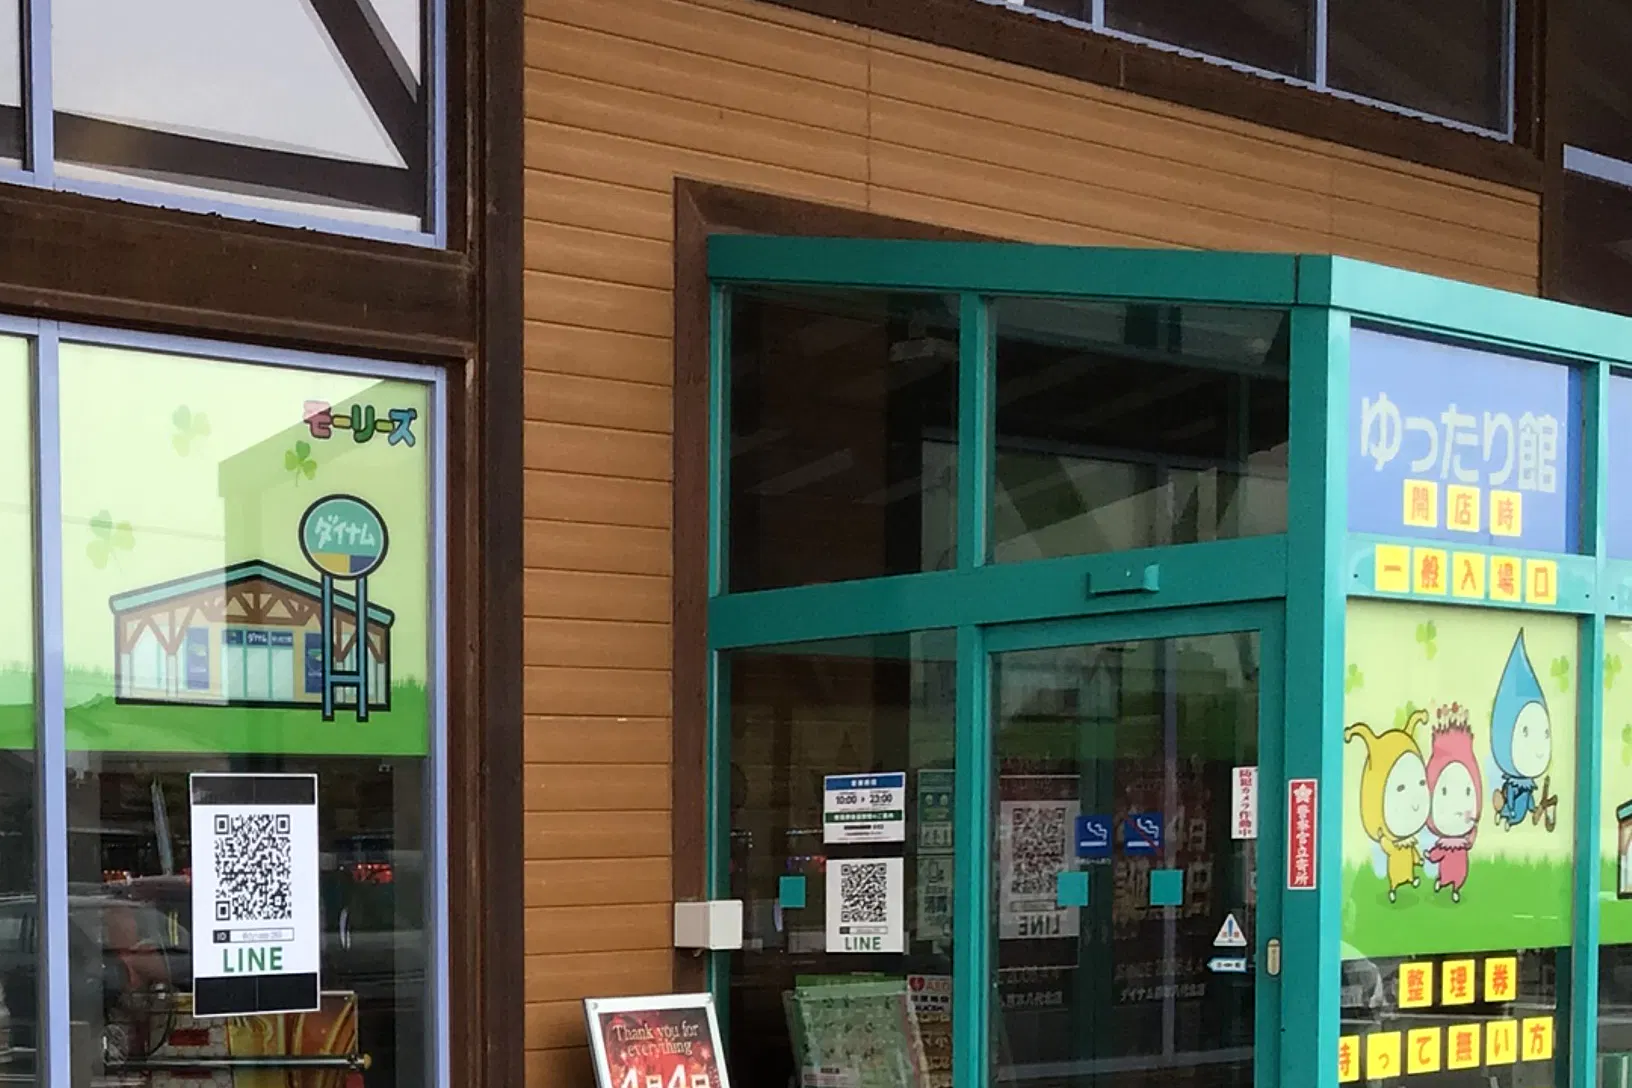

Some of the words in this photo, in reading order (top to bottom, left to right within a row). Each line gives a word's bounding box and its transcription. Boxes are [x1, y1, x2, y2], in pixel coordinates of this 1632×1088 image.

[303, 400, 417, 447] モーリーズ
[1360, 392, 1558, 492] ゆったり館
[314, 514, 376, 549] ダイナム
[1383, 555, 1549, 597] 一般入場口
[223, 946, 283, 973] LINE
[844, 936, 881, 950] LINE
[1407, 964, 1508, 1002] 整理券
[612, 1023, 654, 1041] Thank
[656, 1025, 680, 1042] you
[681, 1020, 699, 1038] for
[628, 1037, 693, 1058] everything
